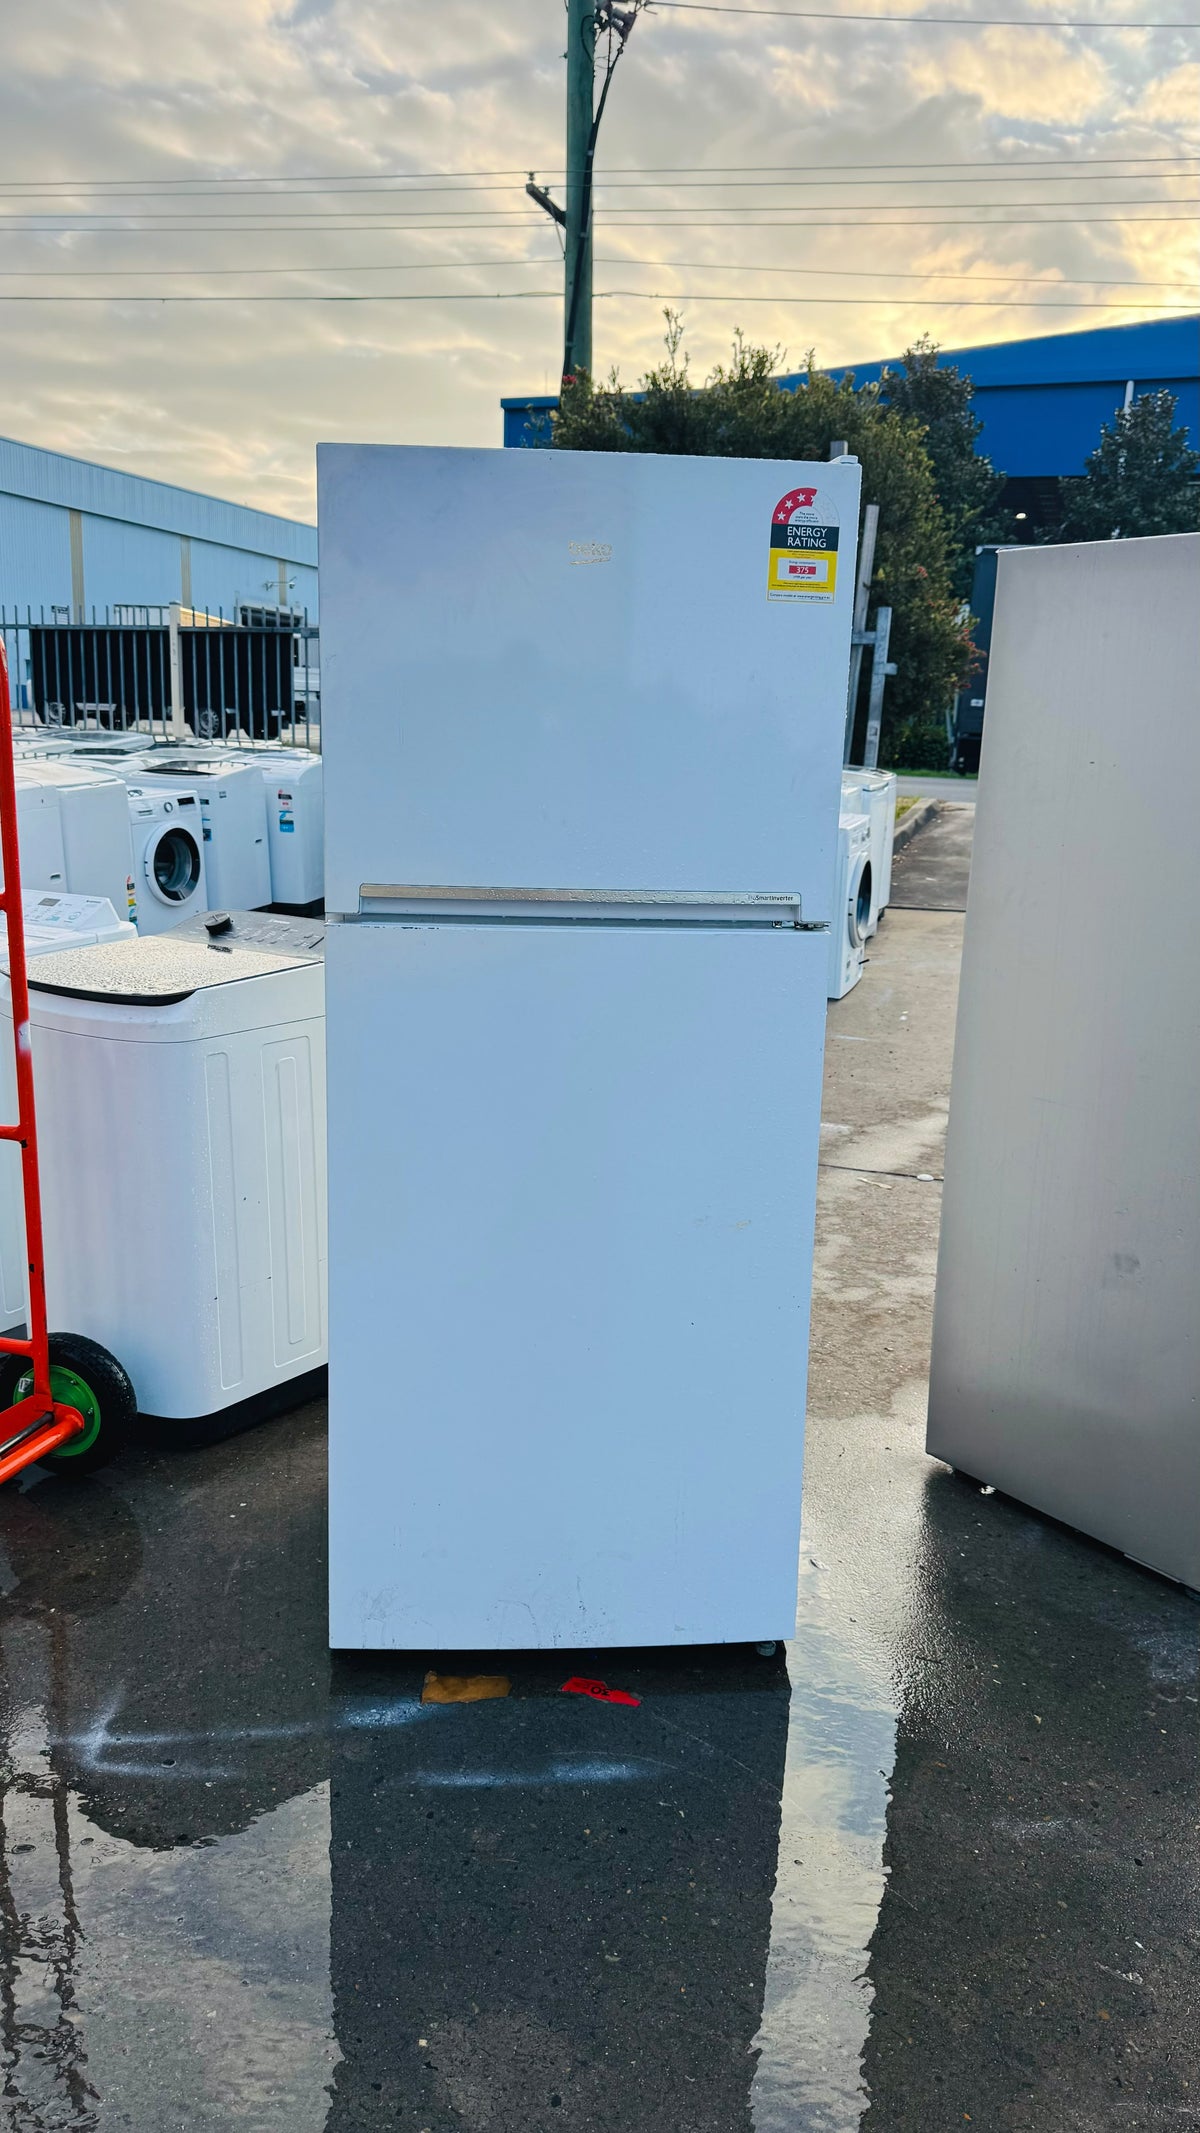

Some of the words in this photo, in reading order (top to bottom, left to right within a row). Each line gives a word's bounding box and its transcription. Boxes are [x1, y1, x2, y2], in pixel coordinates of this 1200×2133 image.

[787, 526, 828, 538] ENERGY
[787, 536, 827, 548] RATING
[796, 566, 809, 574] 375
